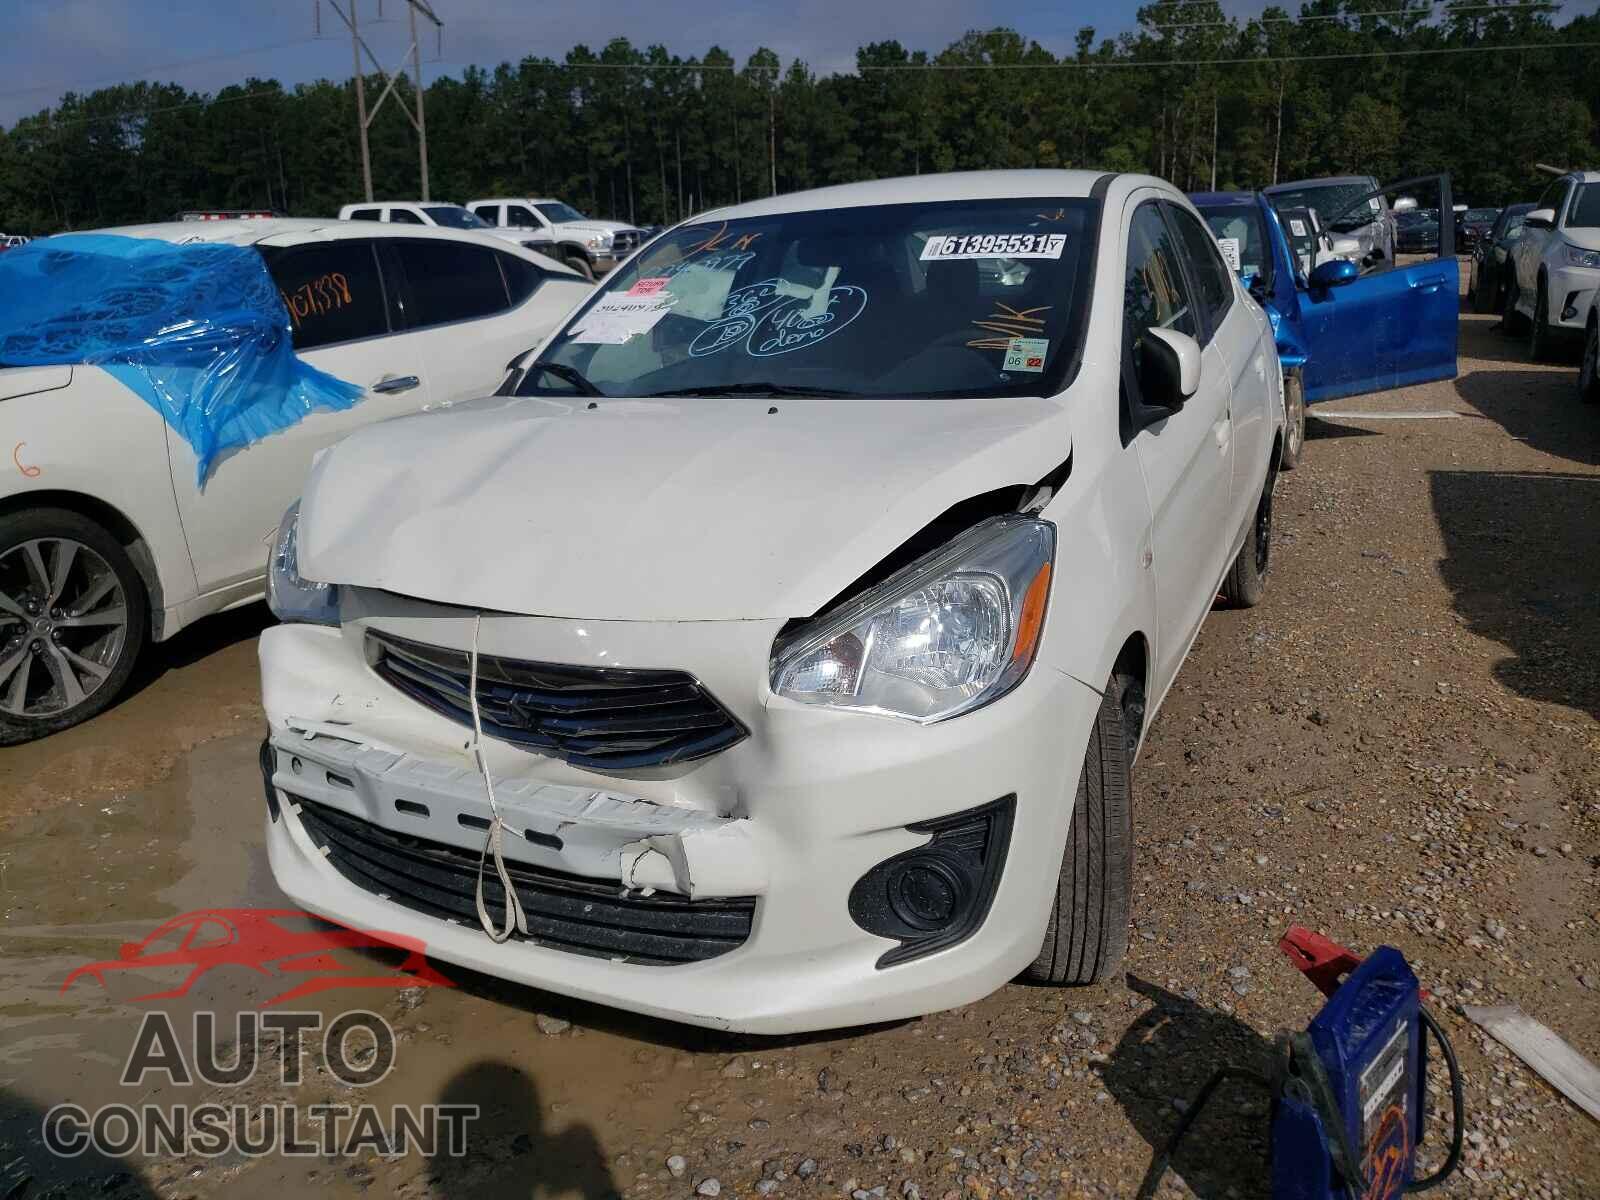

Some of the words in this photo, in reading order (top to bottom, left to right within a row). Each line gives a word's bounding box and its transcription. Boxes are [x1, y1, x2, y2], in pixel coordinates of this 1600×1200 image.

[942, 234, 1047, 255] 61395531
[1008, 356, 1021, 366] 06
[13, 441, 41, 478] 6
